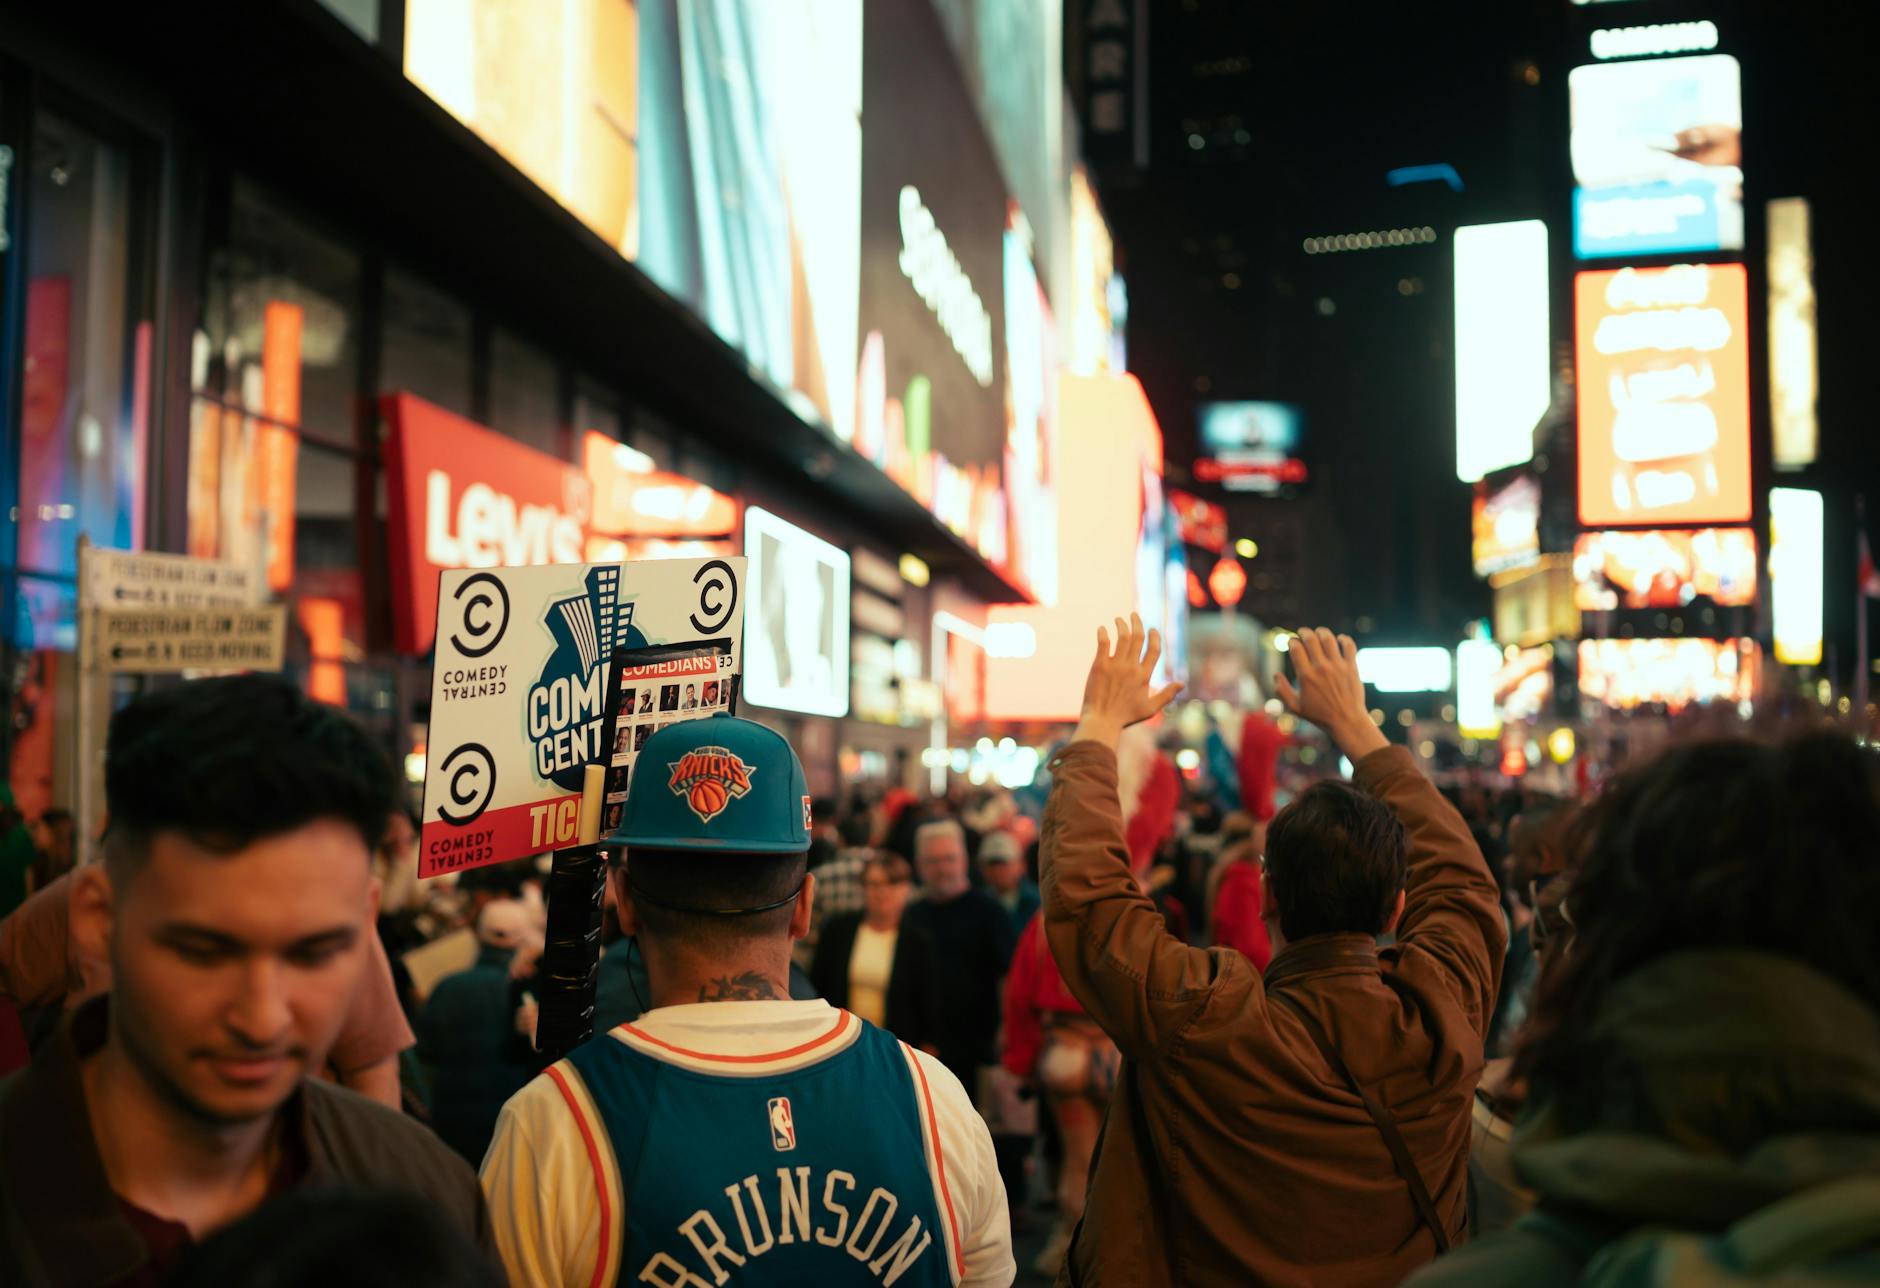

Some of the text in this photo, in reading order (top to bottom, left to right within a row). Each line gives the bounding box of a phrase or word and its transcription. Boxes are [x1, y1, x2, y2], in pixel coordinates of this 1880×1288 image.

[443, 665, 507, 685] COMEDY
[443, 682, 506, 701] CENTRAL
[671, 753, 750, 789] KNICKS
[430, 829, 494, 855] COMEDY
[430, 847, 493, 871] CENTRAL
